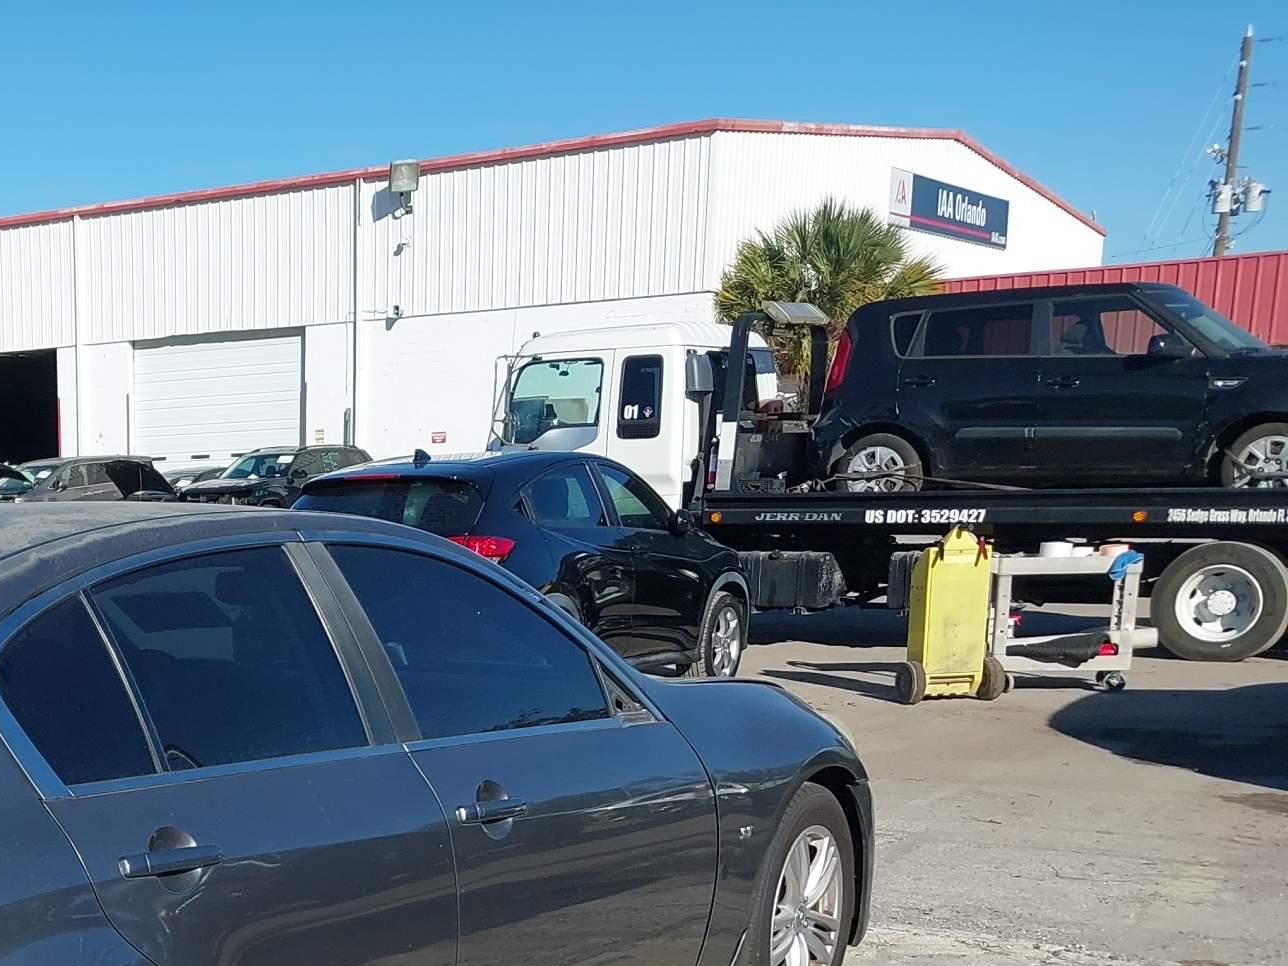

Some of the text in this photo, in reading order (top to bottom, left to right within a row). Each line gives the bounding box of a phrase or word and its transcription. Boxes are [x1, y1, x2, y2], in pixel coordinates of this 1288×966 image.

[937, 188, 987, 227] IAA Orlando
[623, 404, 639, 419] 01
[865, 508, 987, 523] US DOT: 3529427
[1209, 508, 1230, 522] Grass
[1248, 508, 1277, 522] Orlando
